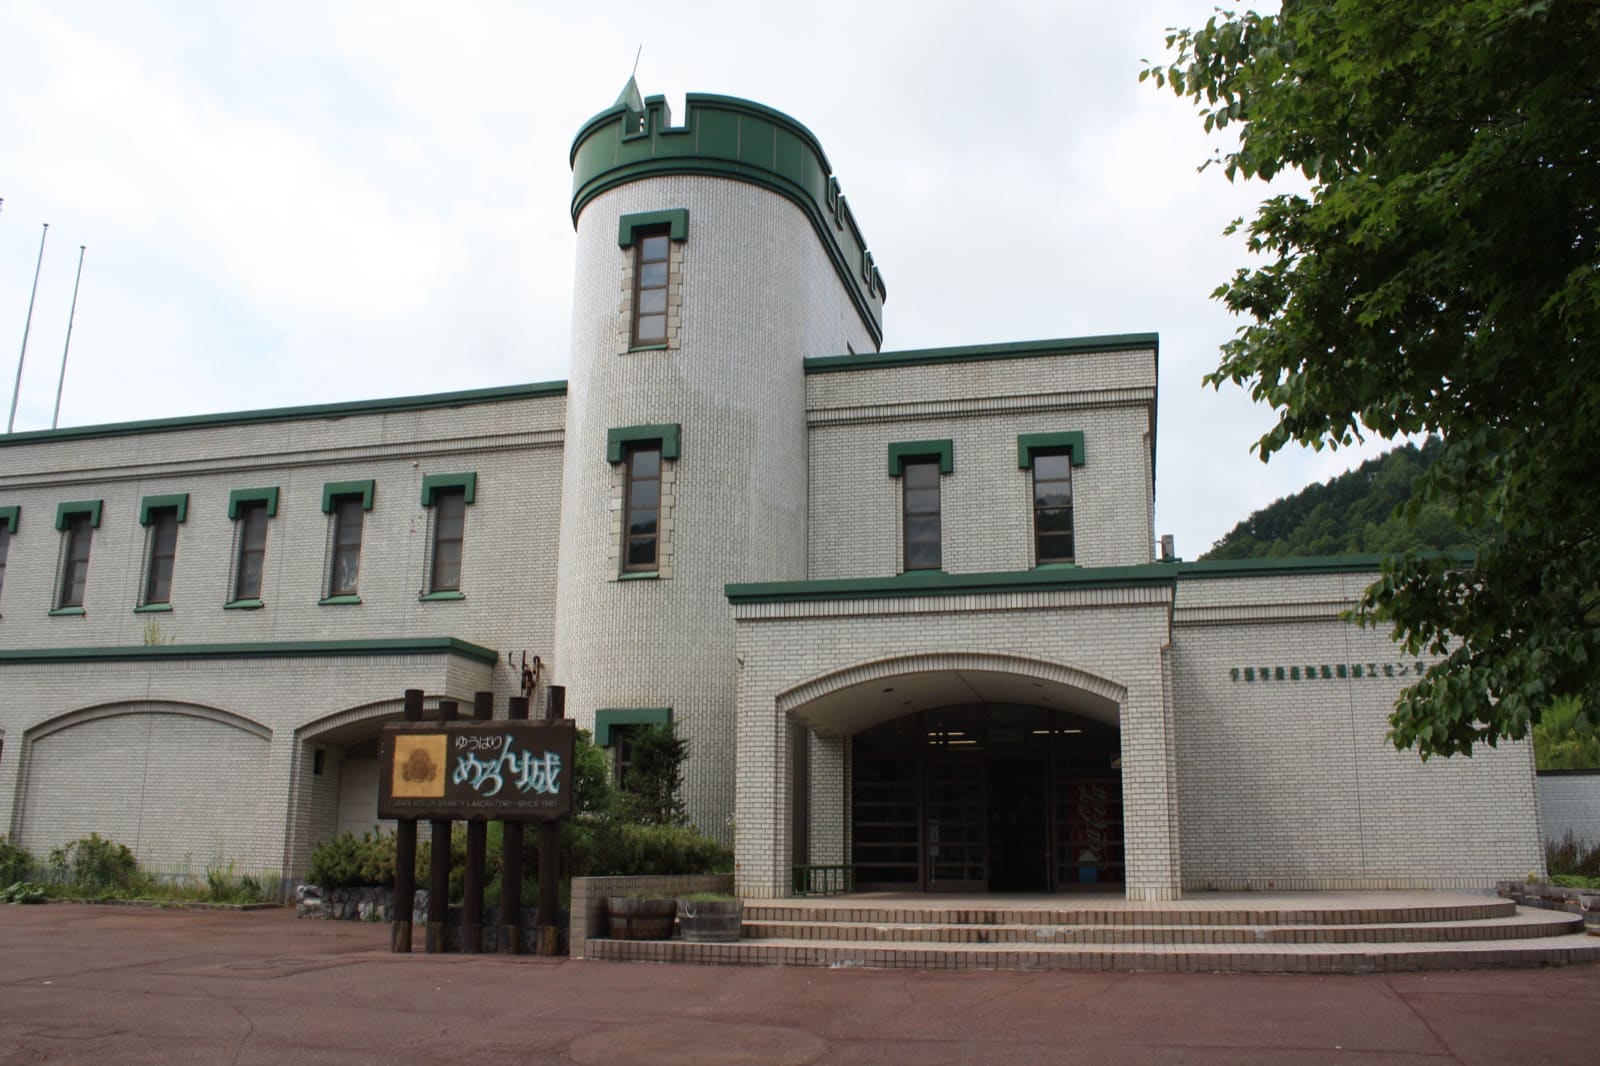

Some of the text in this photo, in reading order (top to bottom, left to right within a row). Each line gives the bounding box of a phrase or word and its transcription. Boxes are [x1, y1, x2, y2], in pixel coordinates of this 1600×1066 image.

[453, 734, 561, 797] めろん城
[455, 735, 503, 750] ゆうばり
[1078, 783, 1108, 871] oca-Cola
